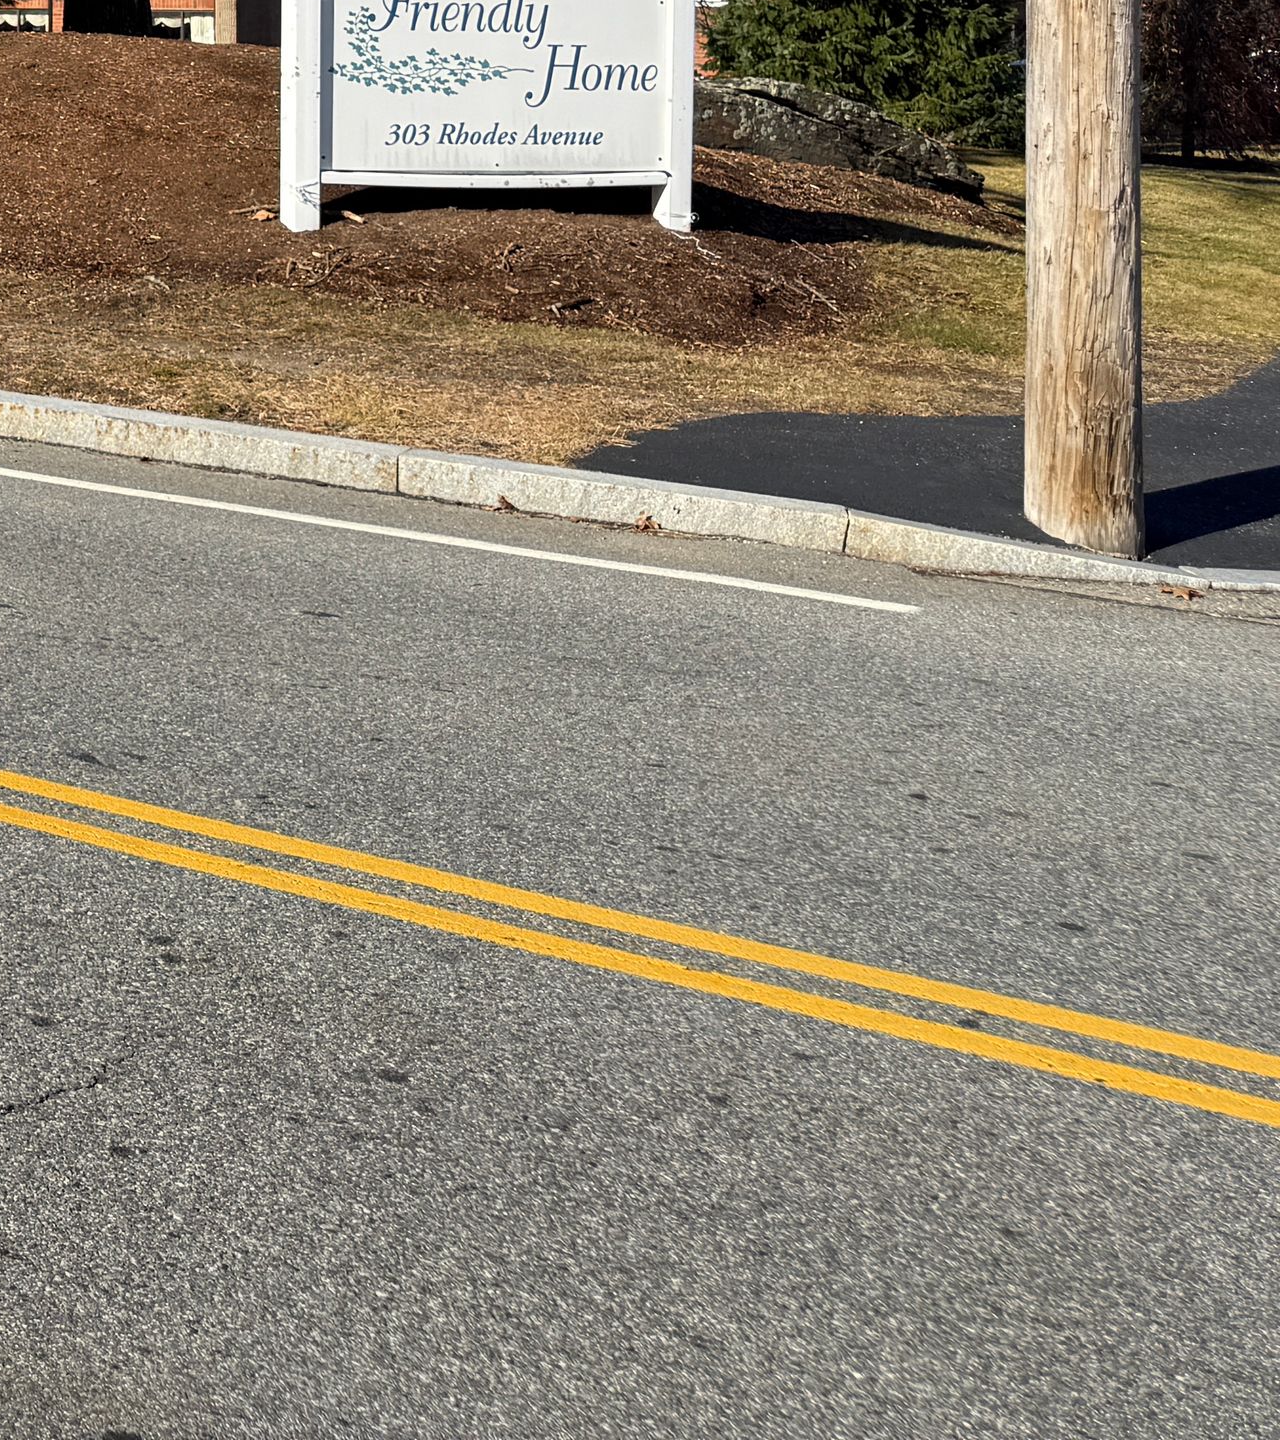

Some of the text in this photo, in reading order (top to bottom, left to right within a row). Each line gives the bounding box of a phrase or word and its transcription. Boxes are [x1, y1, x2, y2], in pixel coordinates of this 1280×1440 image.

[524, 44, 659, 108] Home
[384, 122, 604, 147] 303 Rhodes Avenue
